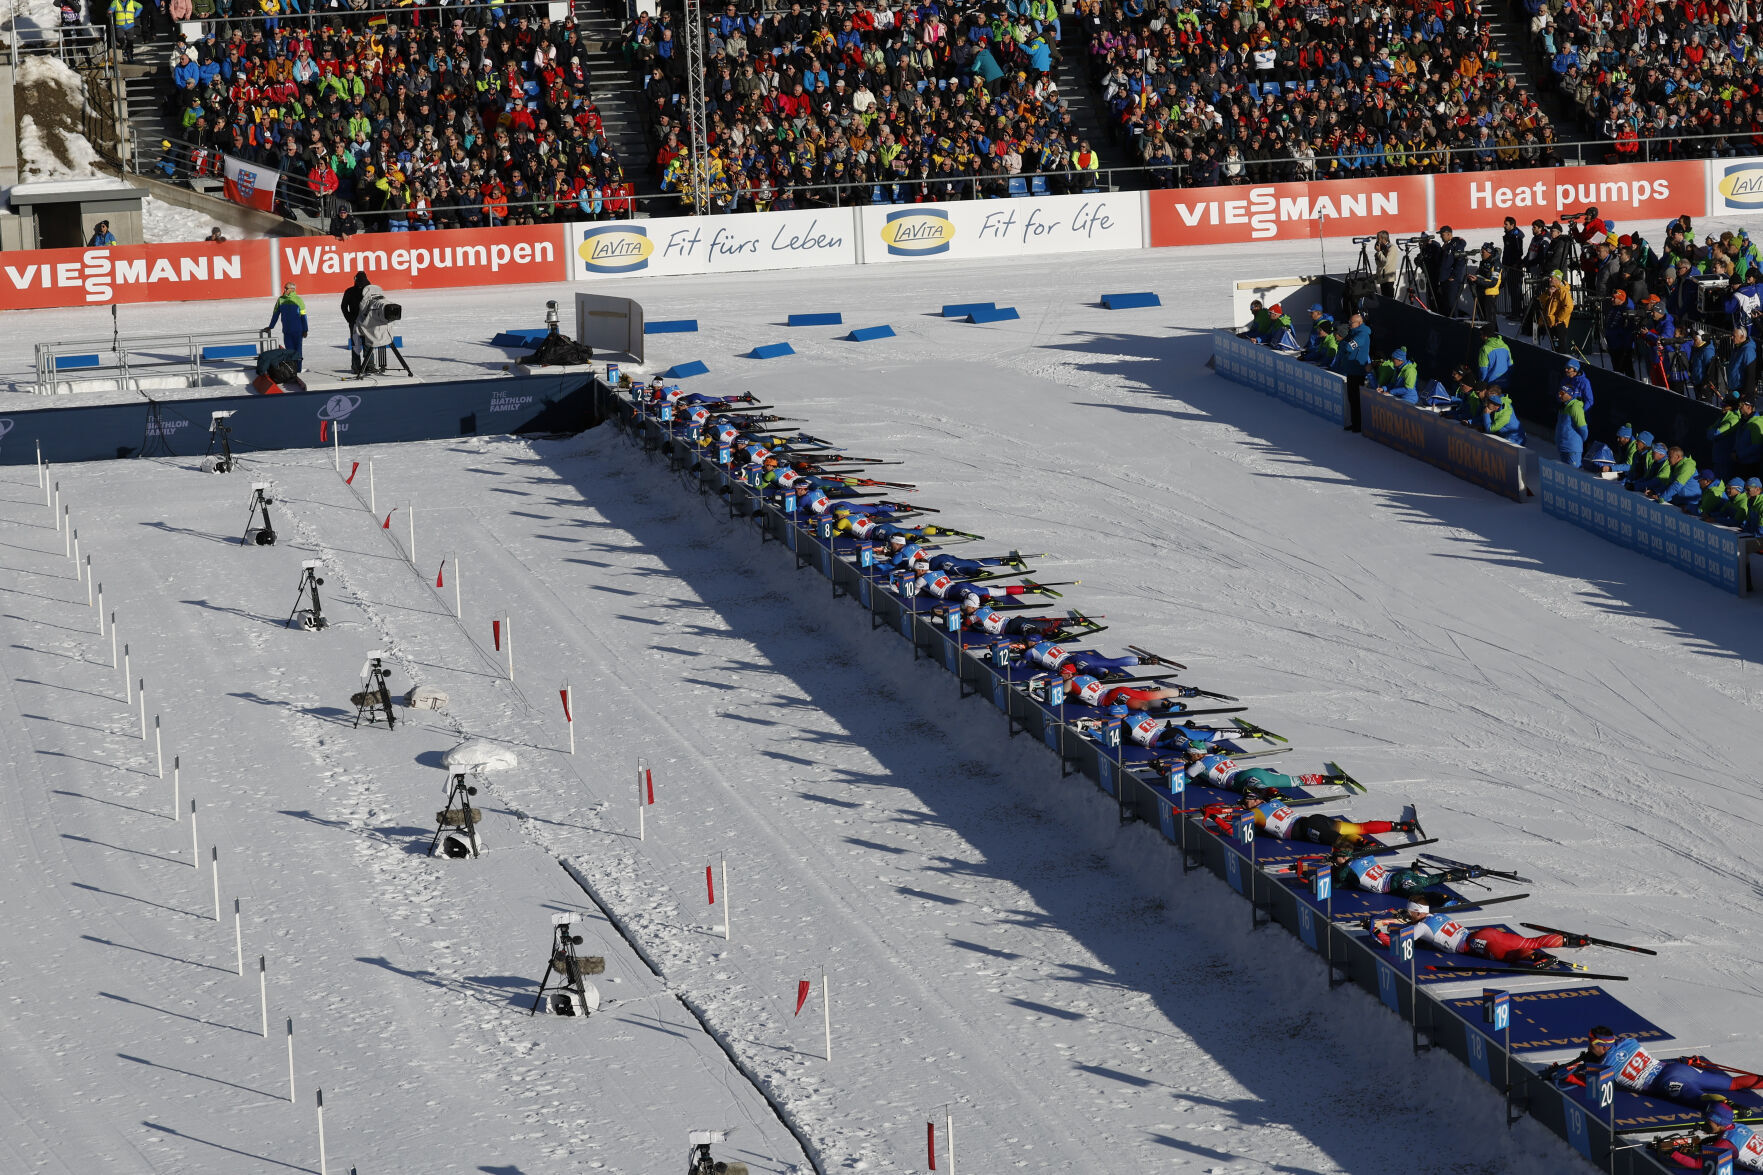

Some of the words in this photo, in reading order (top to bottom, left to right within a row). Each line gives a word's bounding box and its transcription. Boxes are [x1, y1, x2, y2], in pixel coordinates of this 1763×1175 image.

[1470, 181, 1546, 209] Heat
[1556, 179, 1669, 211] pumps
[1174, 187, 1399, 238] VIESSMANN
[979, 209, 1016, 239] Fit
[1023, 208, 1061, 243] for
[663, 227, 701, 257] Fit
[708, 227, 759, 262] fürs
[771, 219, 842, 251] Leben
[285, 240, 554, 276] Wärmepumpen
[4, 249, 241, 302] VIESSMANN
[491, 396, 532, 405] BIATHLON
[637, 389, 642, 400] 2
[490, 403, 520, 412] FAMILY
[664, 408, 669, 420] 3
[692, 428, 698, 440] 4
[722, 450, 728, 463] 5
[755, 473, 760, 486] 6
[788, 497, 794, 510] 7
[824, 523, 830, 538] 8
[864, 551, 870, 566] 9
[905, 582, 914, 596] 10
[951, 614, 959, 630] 11
[1000, 649, 1008, 666] 12
[1054, 686, 1062, 704] 13
[1110, 728, 1120, 747] 14
[1174, 773, 1184, 793] 15
[1243, 823, 1254, 843] 16
[1320, 877, 1330, 898] 17
[1402, 938, 1413, 960] 18
[1382, 967, 1390, 991] 17
[1496, 1004, 1508, 1028] 19
[1472, 1032, 1482, 1060] 18
[1625, 1056, 1644, 1076] 19
[1601, 1080, 1613, 1108] 20
[1571, 1108, 1581, 1134] 19
